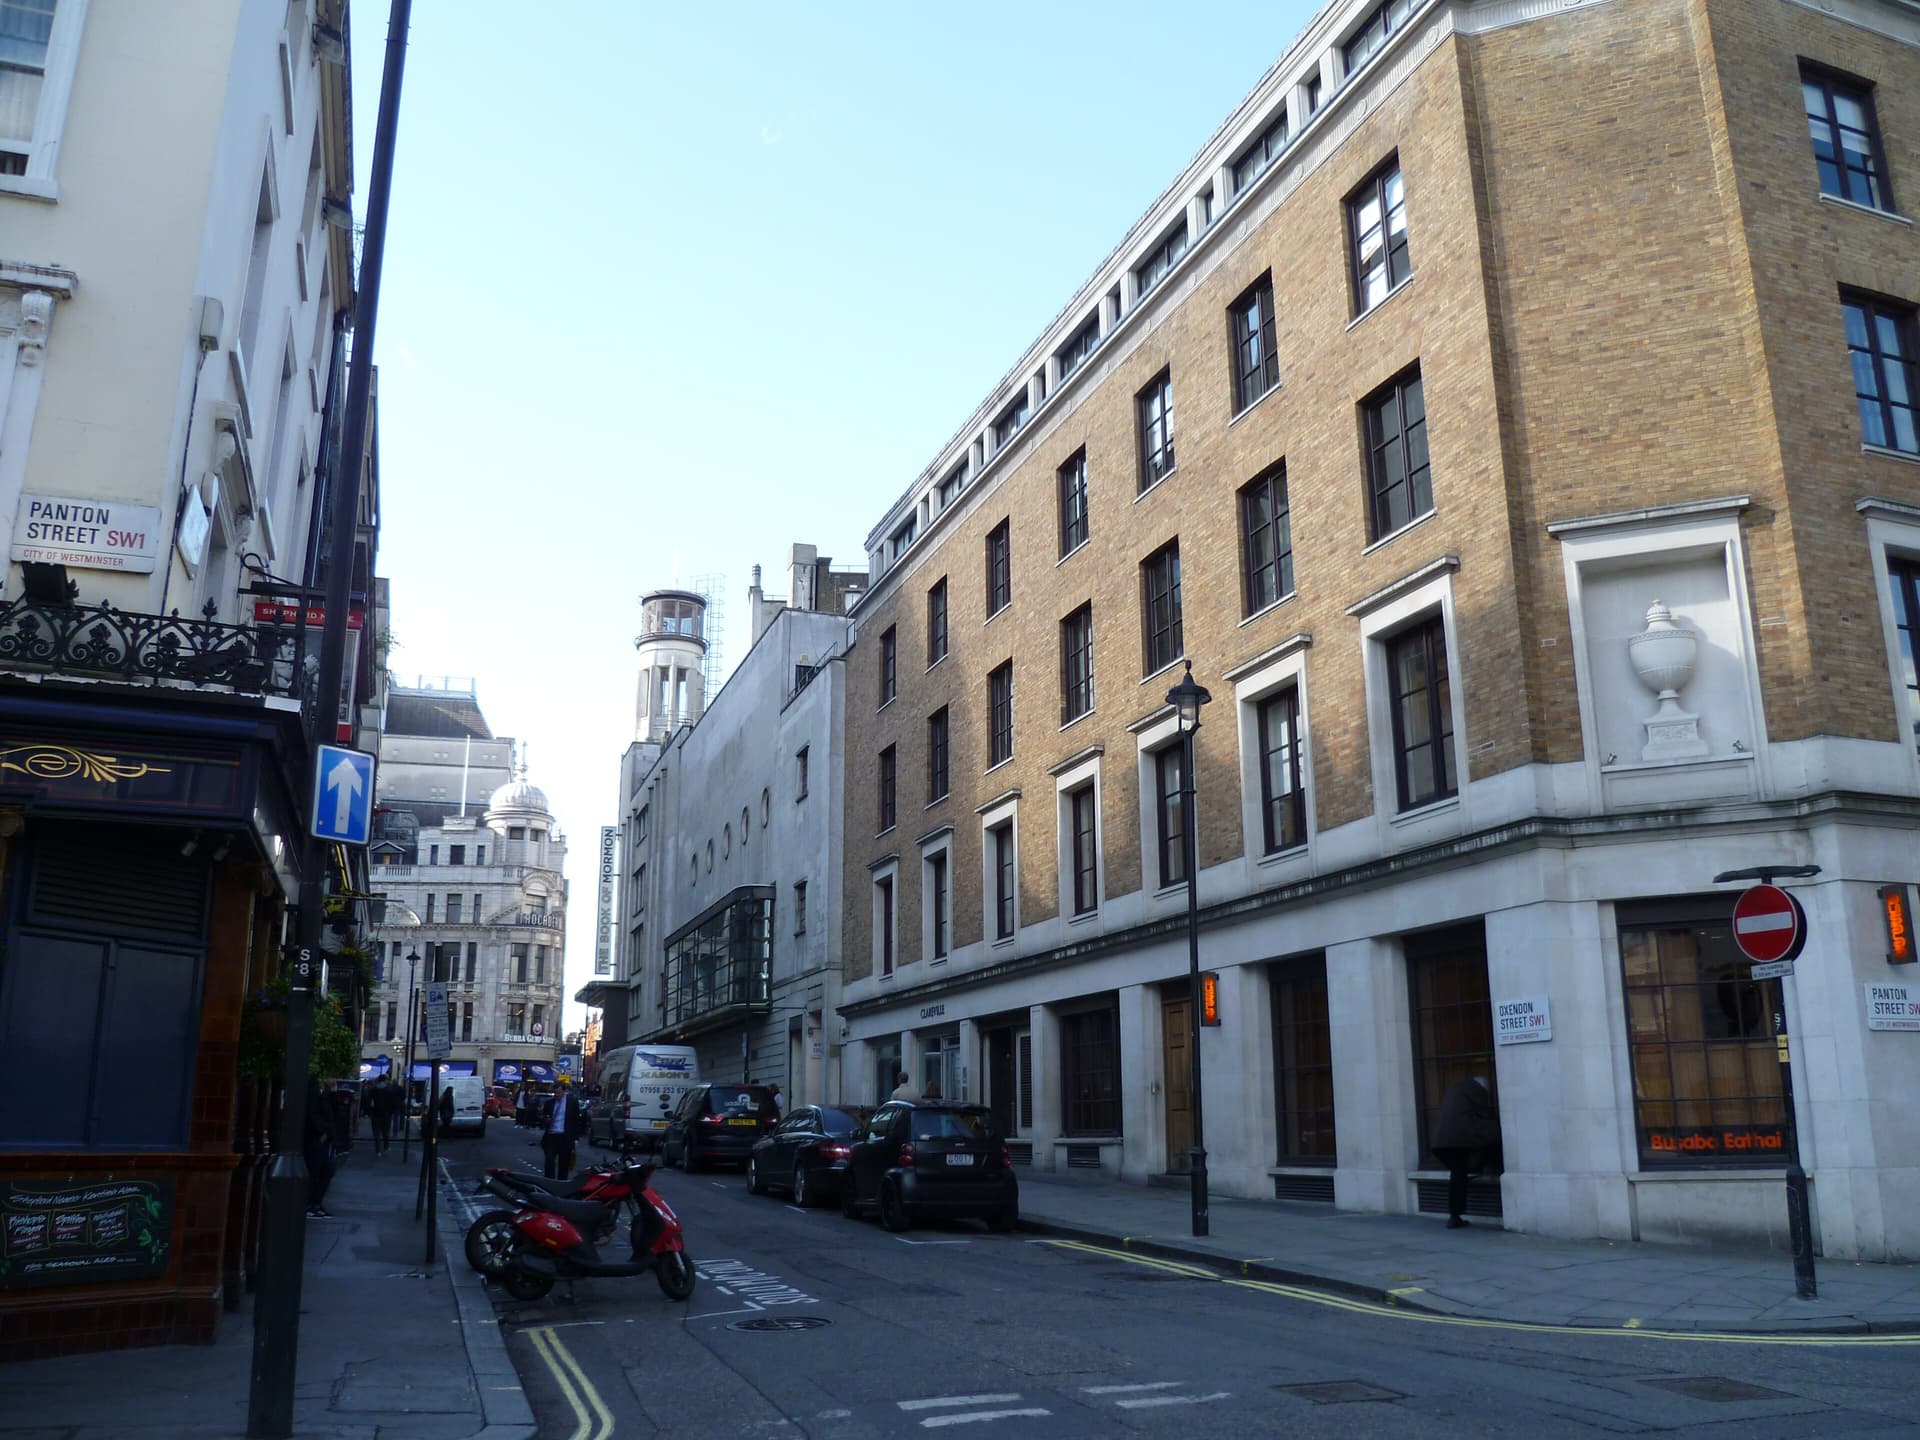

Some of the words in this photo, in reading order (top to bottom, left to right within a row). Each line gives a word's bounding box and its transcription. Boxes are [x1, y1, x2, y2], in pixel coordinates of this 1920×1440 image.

[29, 501, 110, 525] PANTON
[27, 522, 100, 545] STREET
[106, 530, 145, 549] SW1
[23, 549, 43, 558] CITY
[46, 552, 58, 560] OF
[60, 553, 124, 567] WESTMINSTER
[602, 828, 614, 884] MORMON
[601, 886, 612, 904] OF
[600, 908, 610, 944] BOOK
[300, 949, 310, 961] S
[300, 963, 310, 975] 8
[1872, 988, 1907, 1001] PANTON
[1499, 1002, 1533, 1016] OXENDON
[1874, 1002, 1905, 1015] STREET
[1500, 1016, 1528, 1030] STREET
[1529, 1014, 1545, 1027] SW1
[1723, 1128, 1784, 1150] Eathai
[738, 1284, 821, 1305] SOLO
